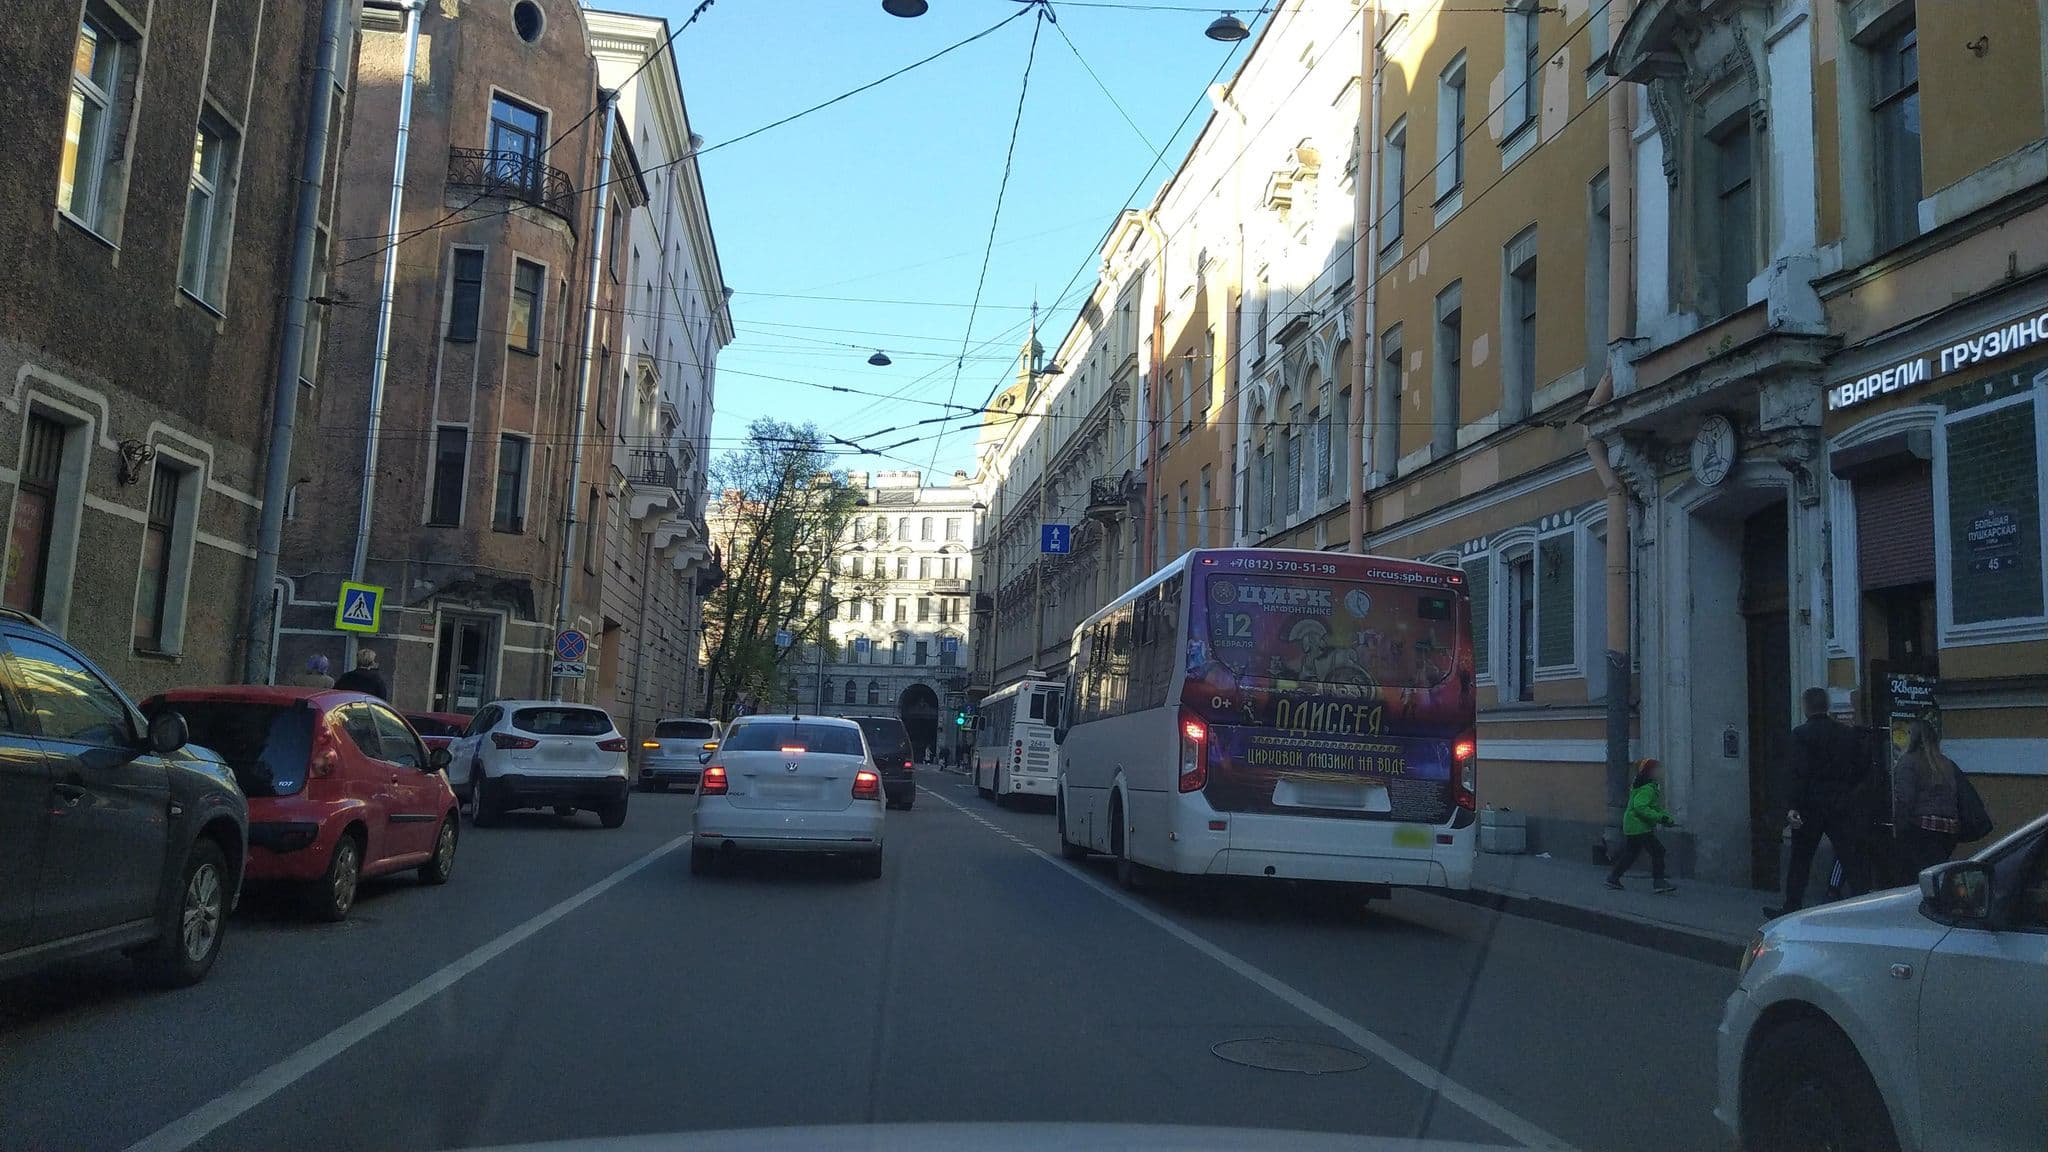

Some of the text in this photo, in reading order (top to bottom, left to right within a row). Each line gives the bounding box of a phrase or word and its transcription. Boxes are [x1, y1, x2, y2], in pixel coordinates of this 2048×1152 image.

[1974, 515, 2009, 530] БОЛЬШАЯ
[1968, 524, 2017, 541] ПУШКАРСКАЯ
[1230, 559, 1336, 575] +7(812) 570-51-98
[1988, 558, 1999, 570] 45
[1367, 568, 1438, 583] circus.spb.ru
[1238, 585, 1332, 607] ЦИРК
[1263, 604, 1332, 616] НА ФОНТАНКЕ
[1224, 613, 1252, 637] 12
[1214, 639, 1253, 648] ФЕВРАЛЯ
[1275, 699, 1383, 738] ОДИССЕЯ
[1248, 748, 1405, 775] ЦИРКОВОЙ МЮЗИКЛ НА ВОДЕ
